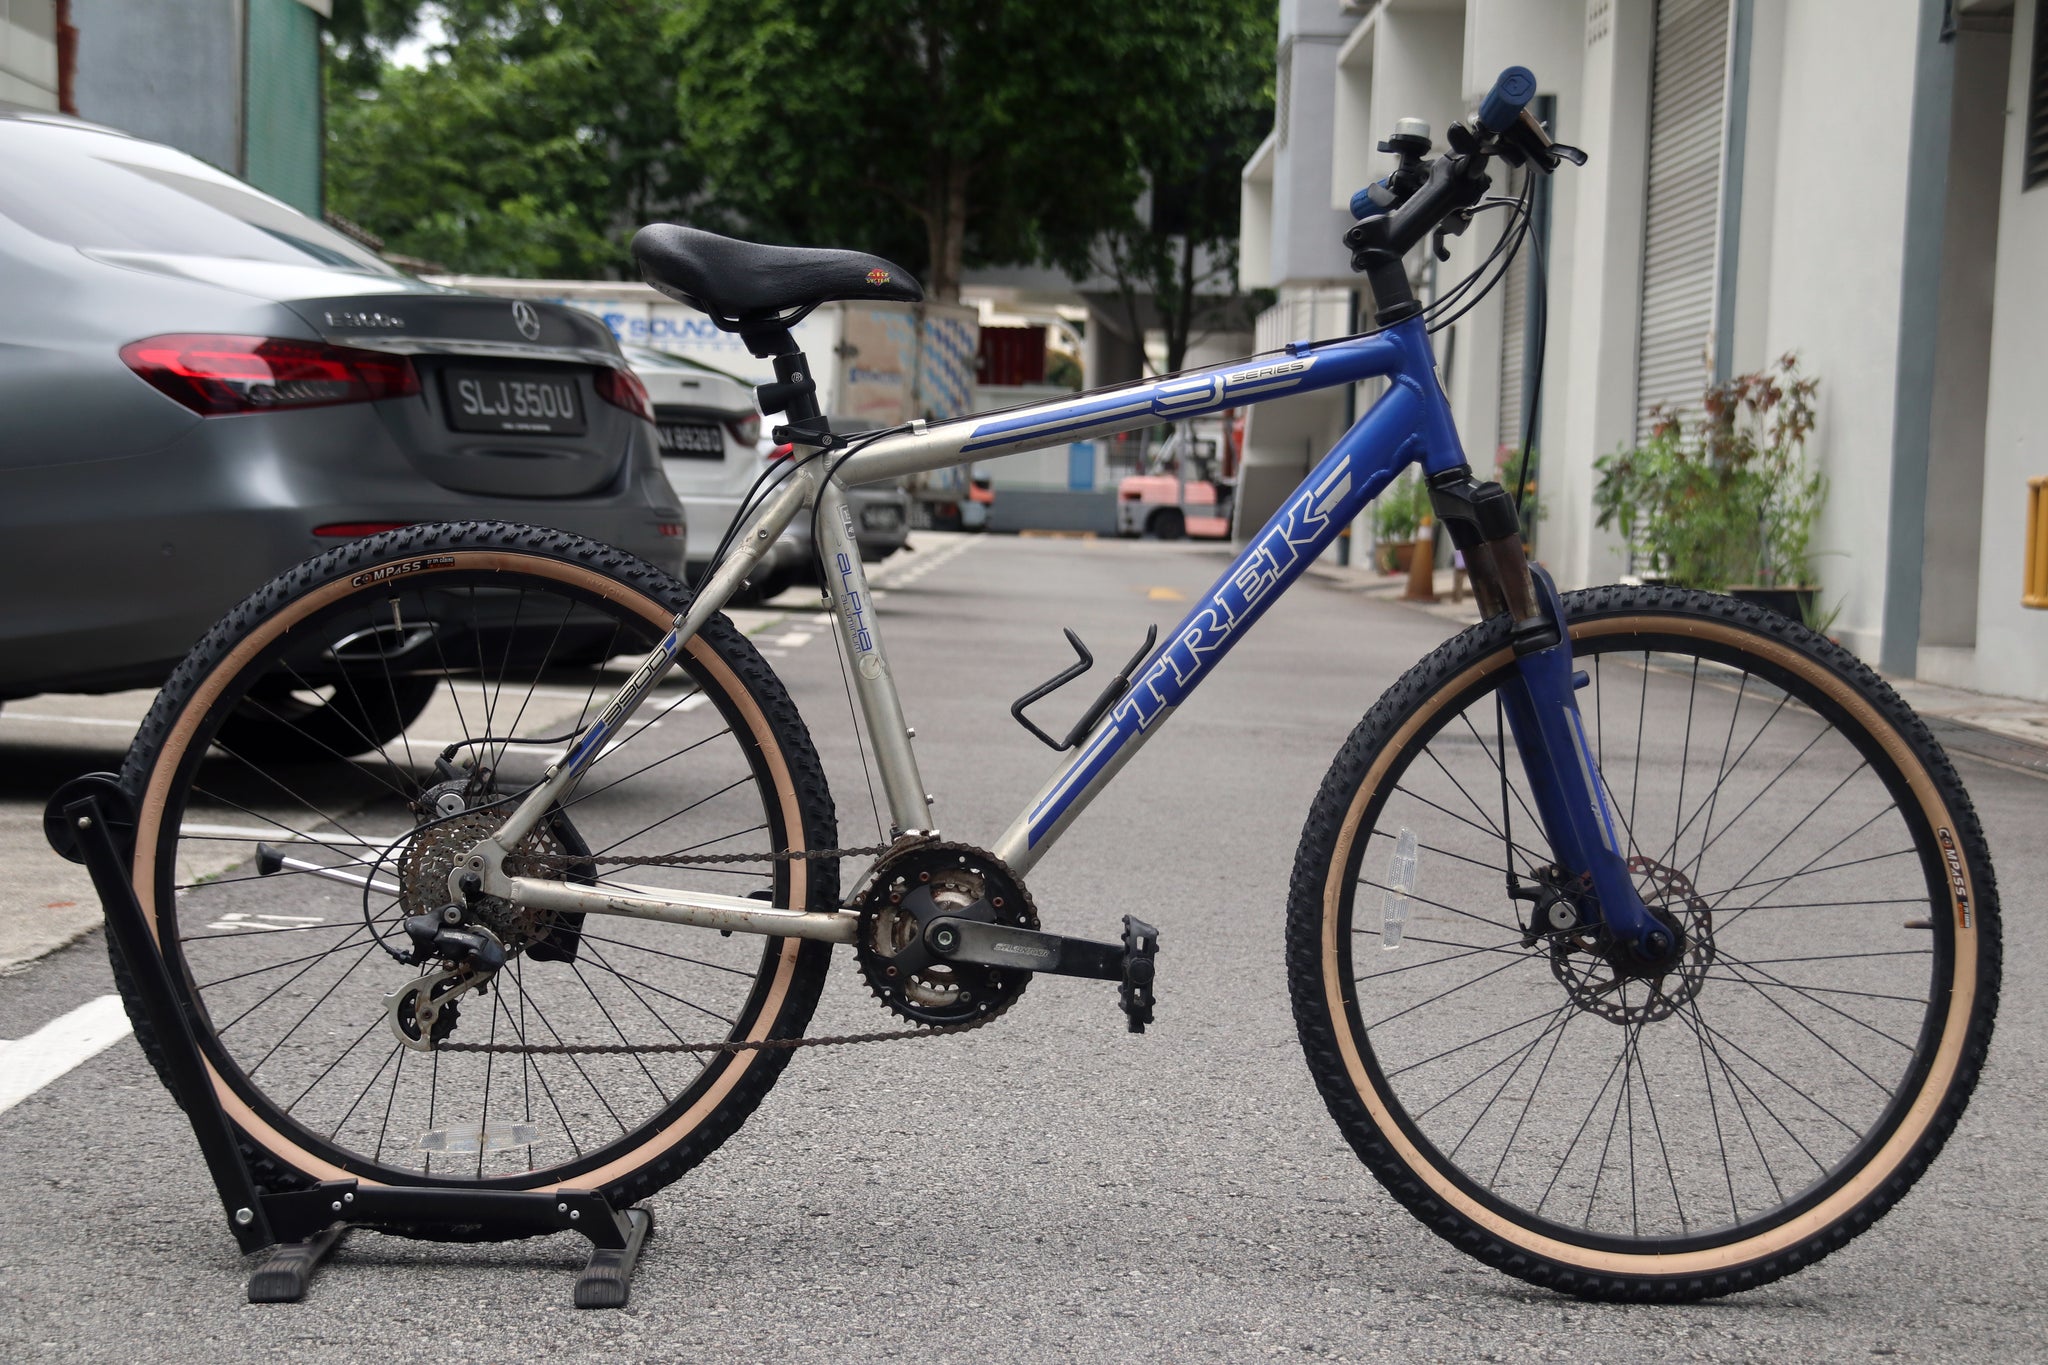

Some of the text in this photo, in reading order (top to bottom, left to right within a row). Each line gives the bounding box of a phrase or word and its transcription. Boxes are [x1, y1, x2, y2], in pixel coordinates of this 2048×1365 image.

[1231, 361, 1305, 383] SERIES
[458, 379, 575, 419] SLJ350U
[352, 561, 422, 588] COMPASS
[1111, 489, 1332, 735] TREK
[1937, 828, 1967, 897] COMPASS
